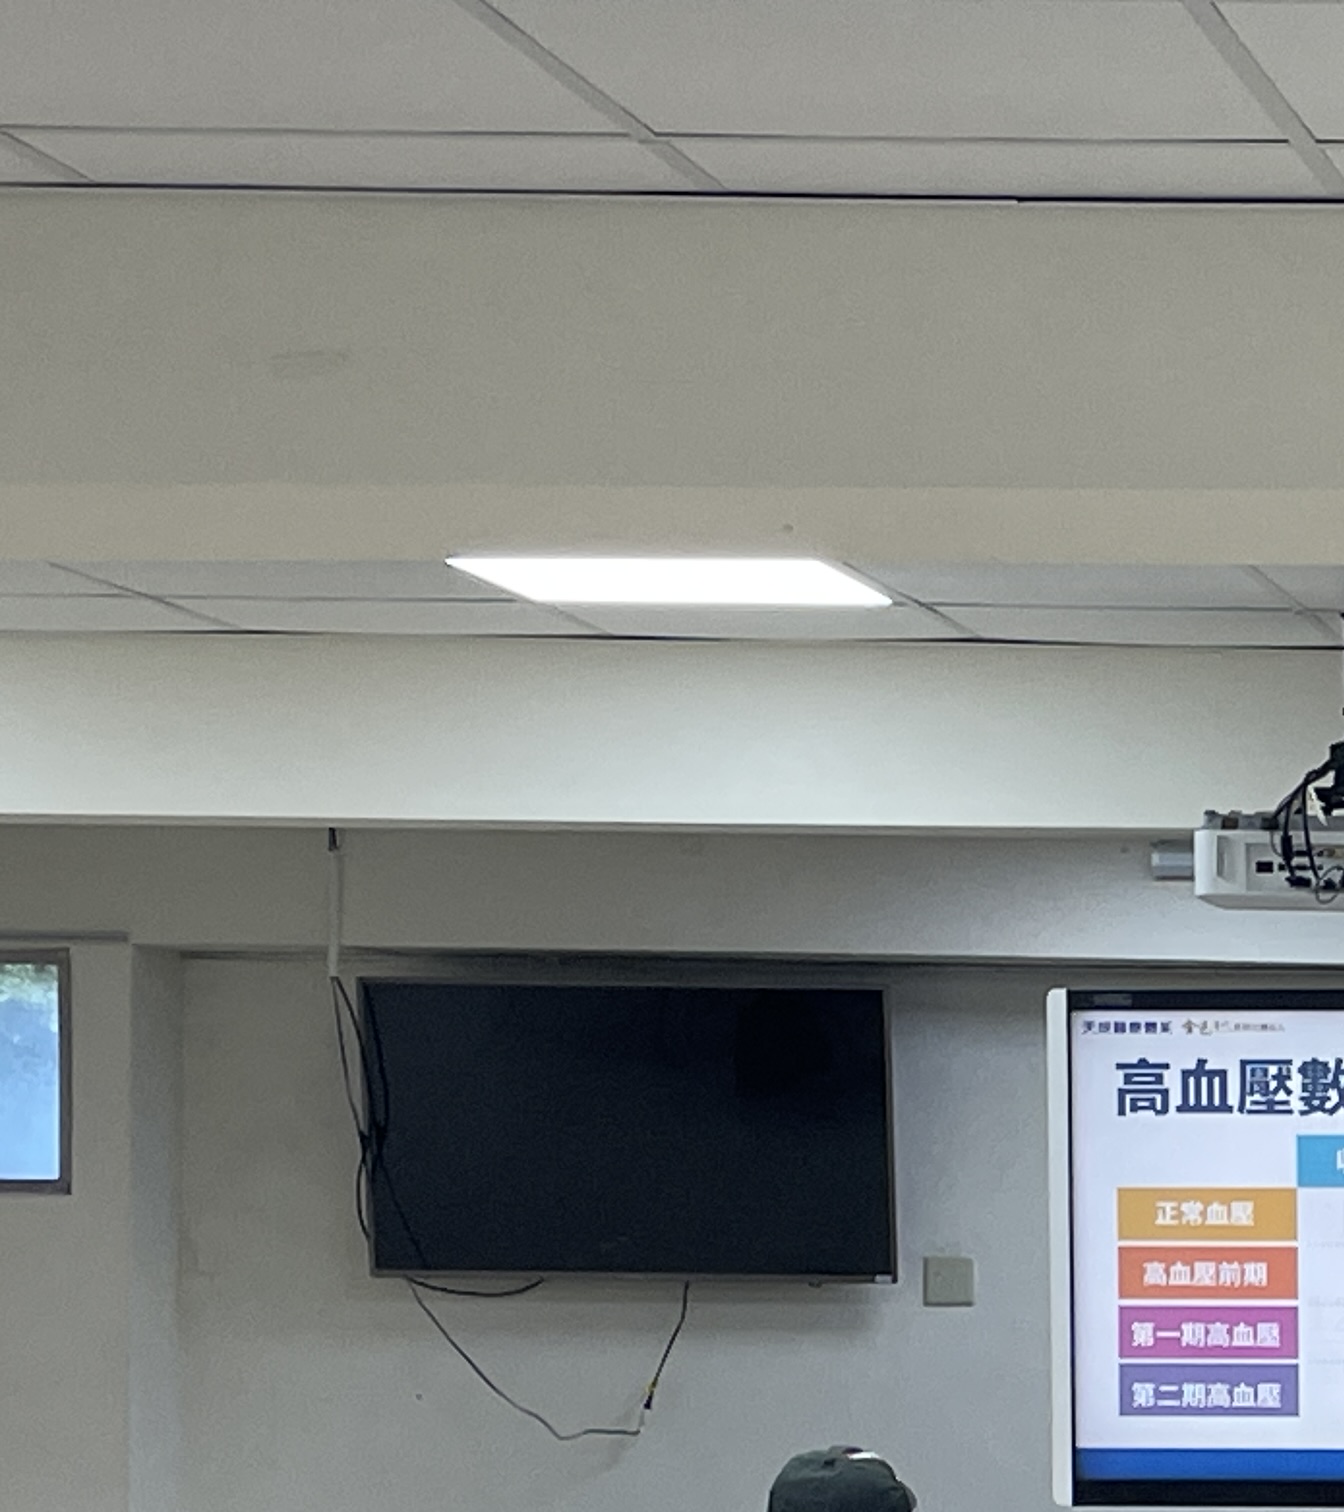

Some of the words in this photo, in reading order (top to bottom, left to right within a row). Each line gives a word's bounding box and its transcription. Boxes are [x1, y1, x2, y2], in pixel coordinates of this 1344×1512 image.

[1155, 1200, 1254, 1227] 正常血壓
[1142, 1261, 1268, 1287] 高血壓前期
[1131, 1322, 1280, 1348] 第一期高血壓
[1132, 1382, 1281, 1408] 第二期高血壓
